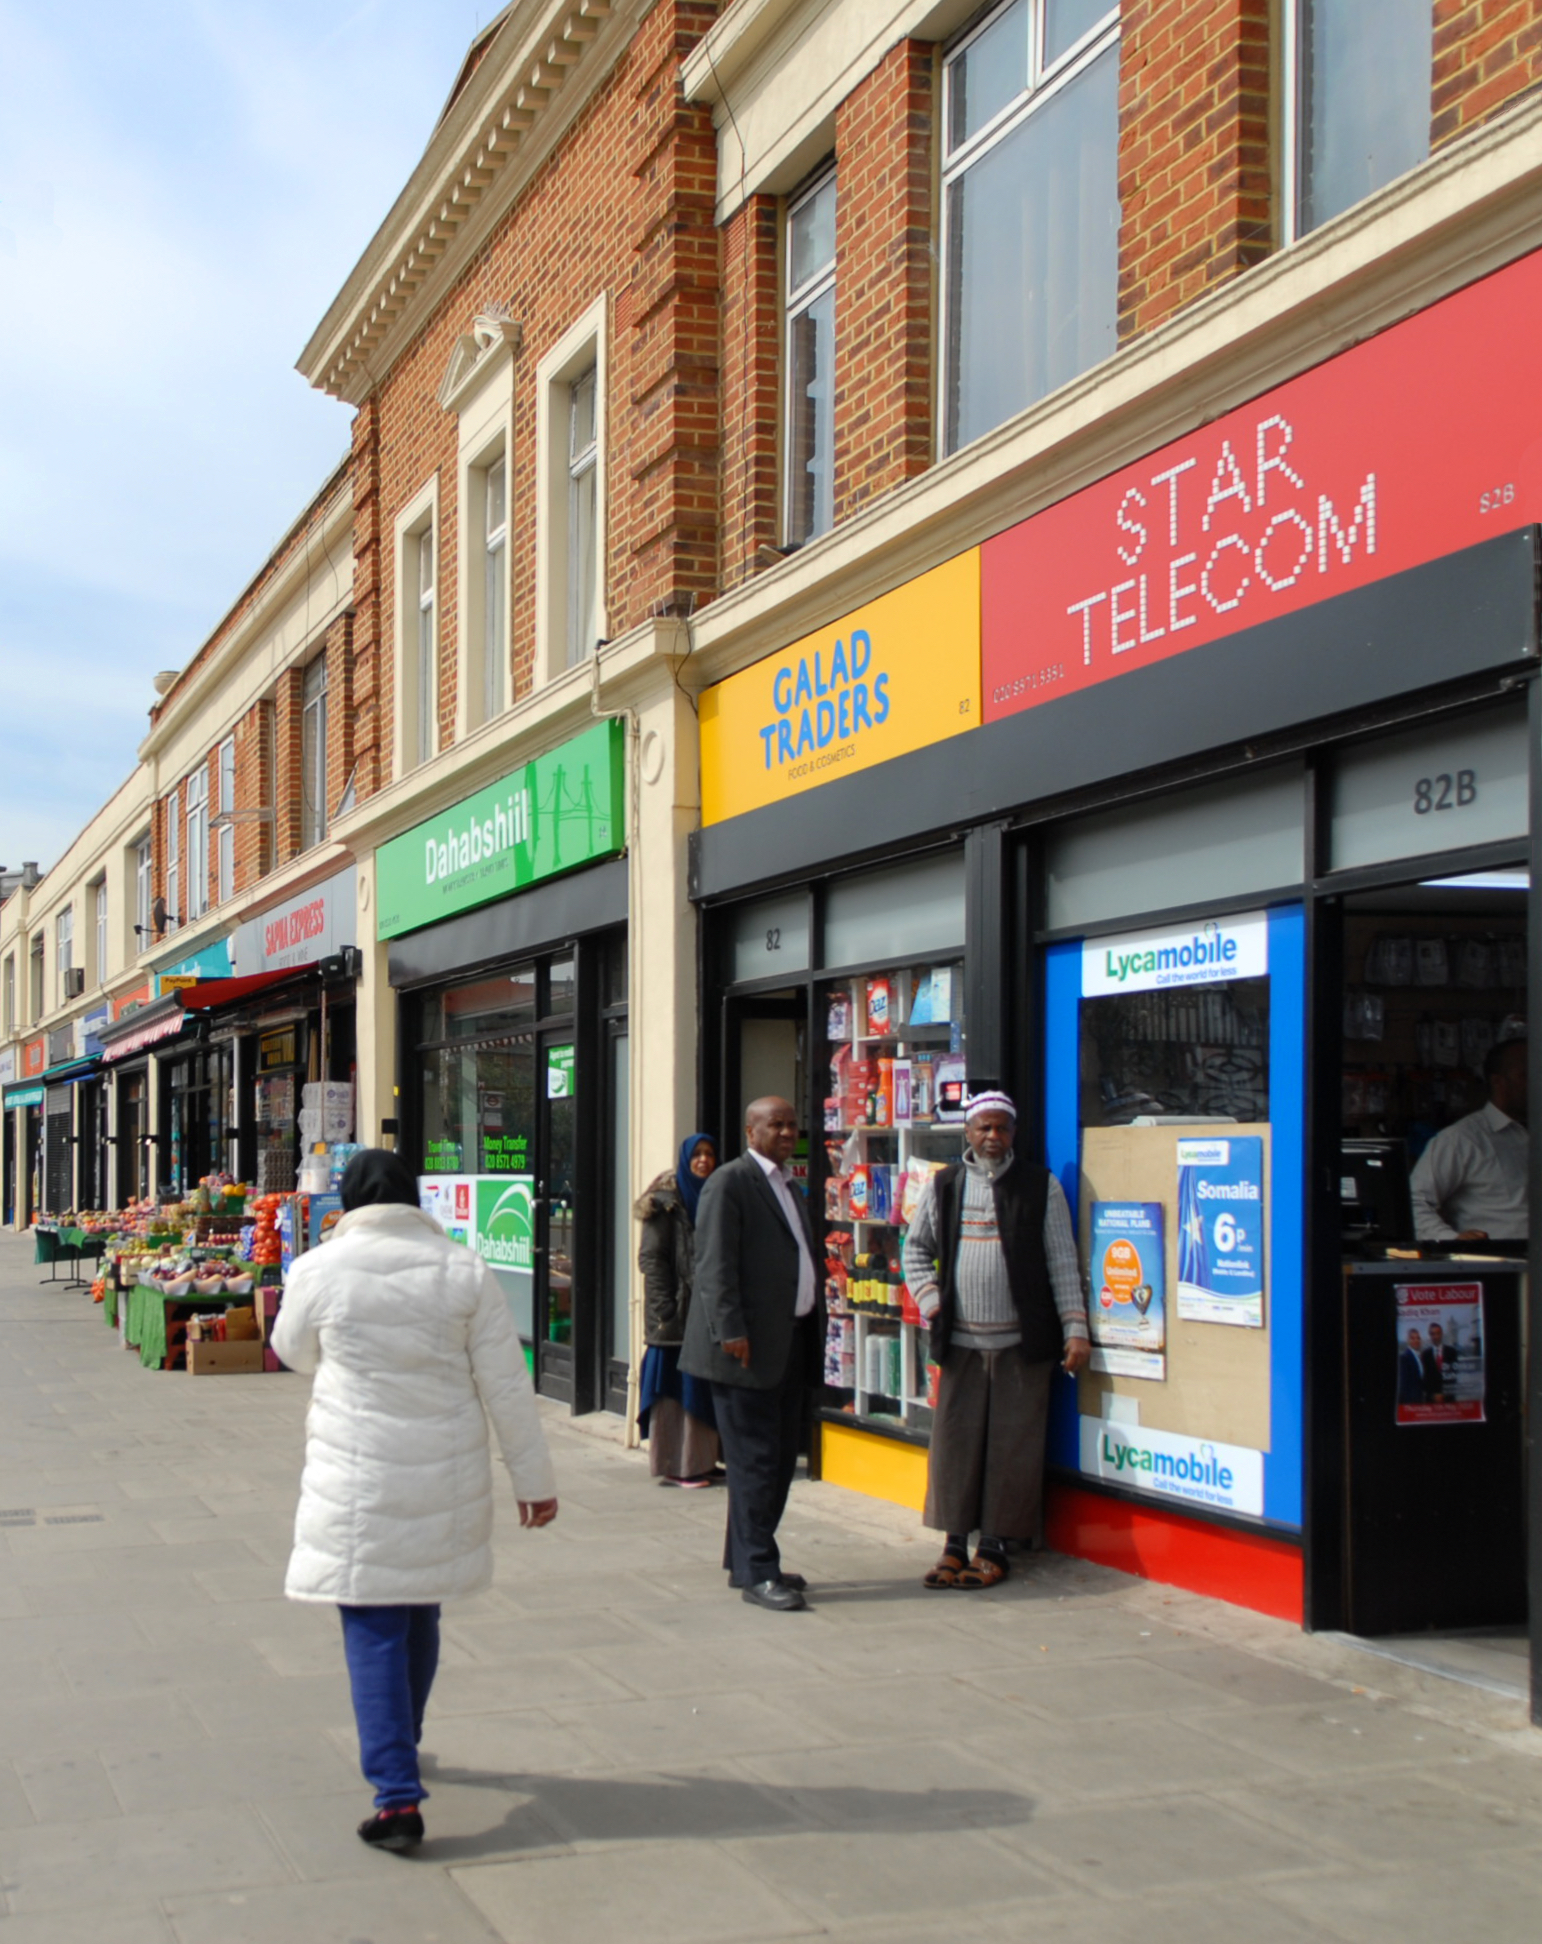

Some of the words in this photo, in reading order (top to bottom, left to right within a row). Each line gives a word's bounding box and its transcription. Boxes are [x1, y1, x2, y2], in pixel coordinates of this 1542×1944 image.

[1117, 414, 1304, 566] STAR
[1066, 472, 1376, 665] TELECOM
[773, 628, 872, 714] GALAD
[759, 672, 890, 771] TRADERS
[958, 698, 970, 715] 82
[788, 762, 808, 781] FOOD
[815, 743, 857, 770] COSMETICS
[1414, 769, 1477, 815] 82B
[425, 788, 528, 885] Dahabshiil
[289, 897, 325, 947] EXPRESS
[766, 927, 781, 951] 82
[1106, 932, 1238, 982] Lycamobile
[1156, 973, 1171, 985] Call
[1171, 972, 1185, 984] the
[1185, 968, 1208, 981] world
[1208, 967, 1219, 978] for
[1220, 965, 1238, 977] less
[483, 1135, 503, 1154] Money
[503, 1134, 527, 1151] Transfer
[484, 1154, 496, 1169] 020
[496, 1154, 510, 1169] 8571
[1196, 1180, 1260, 1200] Somalia
[477, 1231, 530, 1265] Dahabshiil
[1410, 1290, 1436, 1301] Vote
[1438, 1287, 1477, 1300] Labour
[1102, 1434, 1234, 1490] Lycamobile
[1168, 1480, 1181, 1493] the
[1182, 1486, 1204, 1499] world
[1205, 1489, 1217, 1501] for
